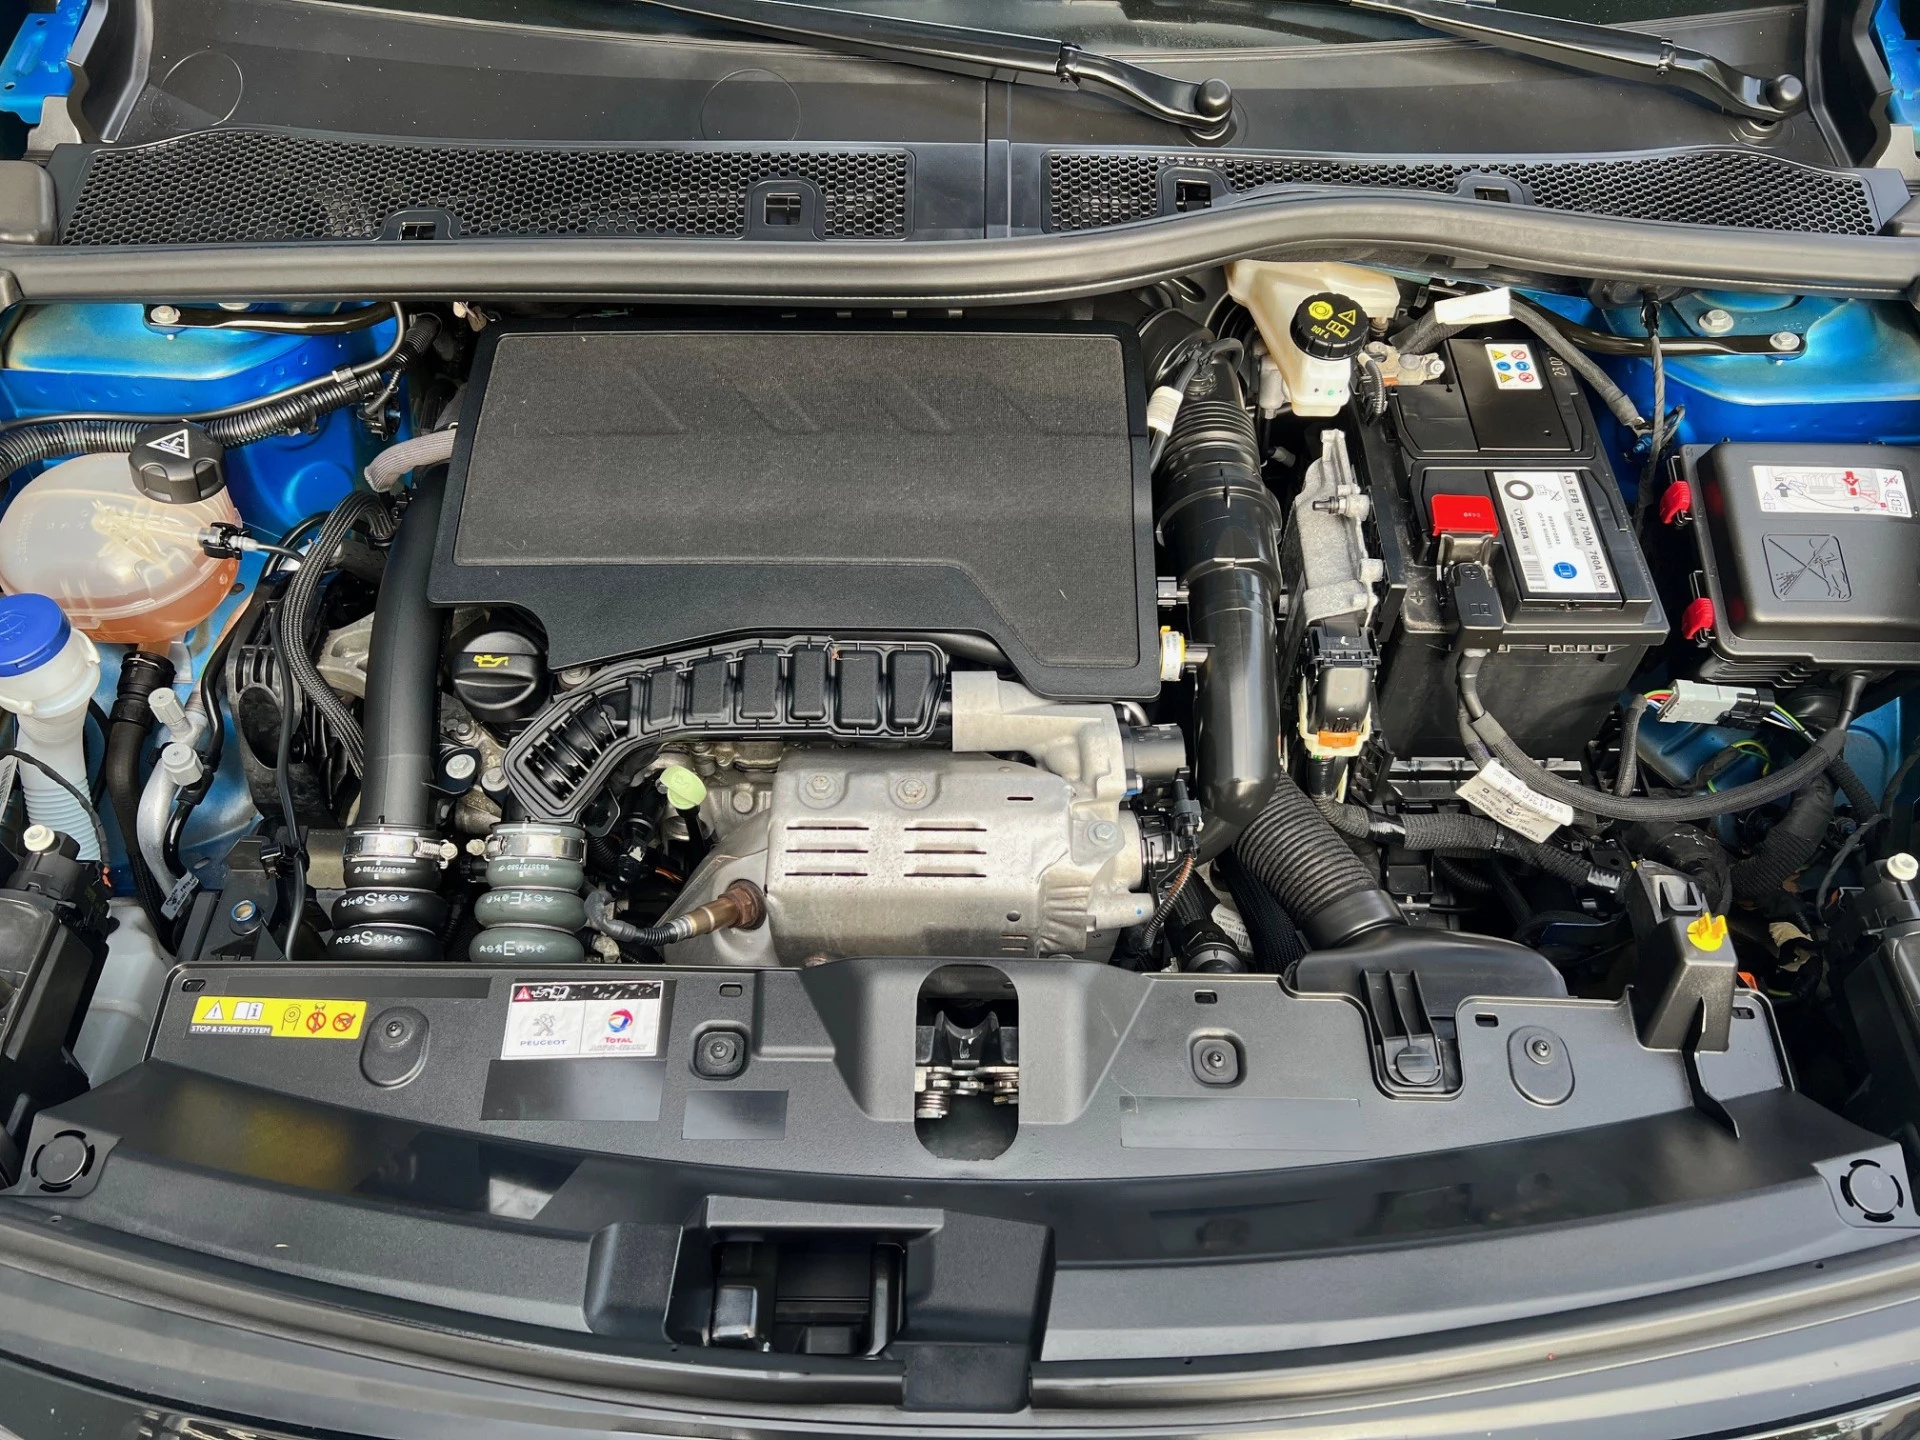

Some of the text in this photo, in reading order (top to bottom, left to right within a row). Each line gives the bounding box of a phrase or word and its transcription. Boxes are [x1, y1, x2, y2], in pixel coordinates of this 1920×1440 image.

[1310, 325, 1325, 336] DOT
[1563, 475, 1573, 485] L3
[1568, 488, 1580, 504] EFB
[1575, 507, 1586, 522] 12V
[1517, 516, 1529, 540] VARTA
[1580, 526, 1594, 546] 70Ah
[1589, 550, 1603, 571] 760A
[1595, 572, 1610, 589] (EN)
